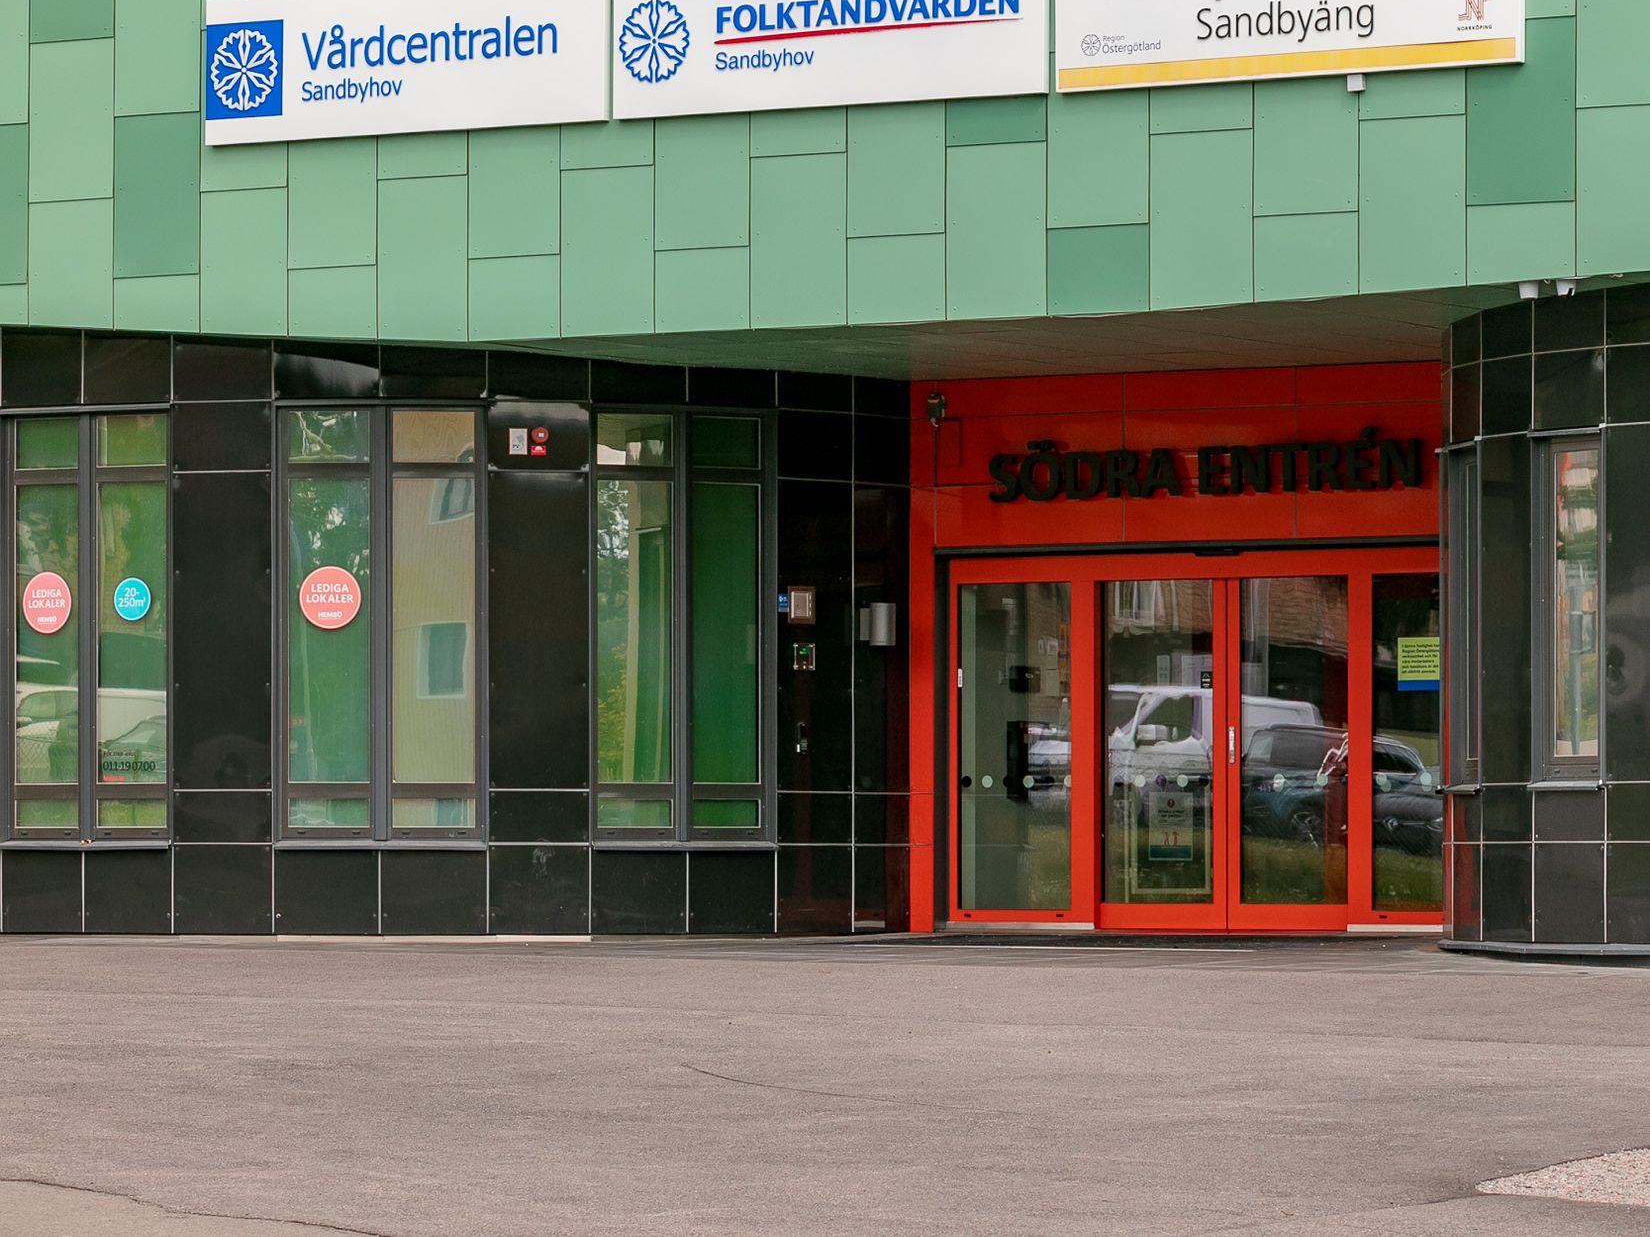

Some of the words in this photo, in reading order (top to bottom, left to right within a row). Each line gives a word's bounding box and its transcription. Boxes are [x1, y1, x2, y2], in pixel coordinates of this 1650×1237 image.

[1196, 1, 1376, 43] Sandbyäng
[300, 14, 559, 71] Vårdcentralen
[1102, 35, 1125, 43] Region
[1102, 40, 1161, 54] Östergötland
[714, 48, 815, 73] Sandbyhov
[300, 76, 404, 103] Sandbyhov
[988, 439, 1182, 503] SÖDRA
[1198, 426, 1421, 495] ENTRÉN
[31, 589, 62, 598] LEDIGA
[124, 587, 140, 597] 20-
[311, 584, 349, 593] LEDIGA
[28, 599, 66, 609] LOKALER
[306, 594, 354, 603] LOKALER
